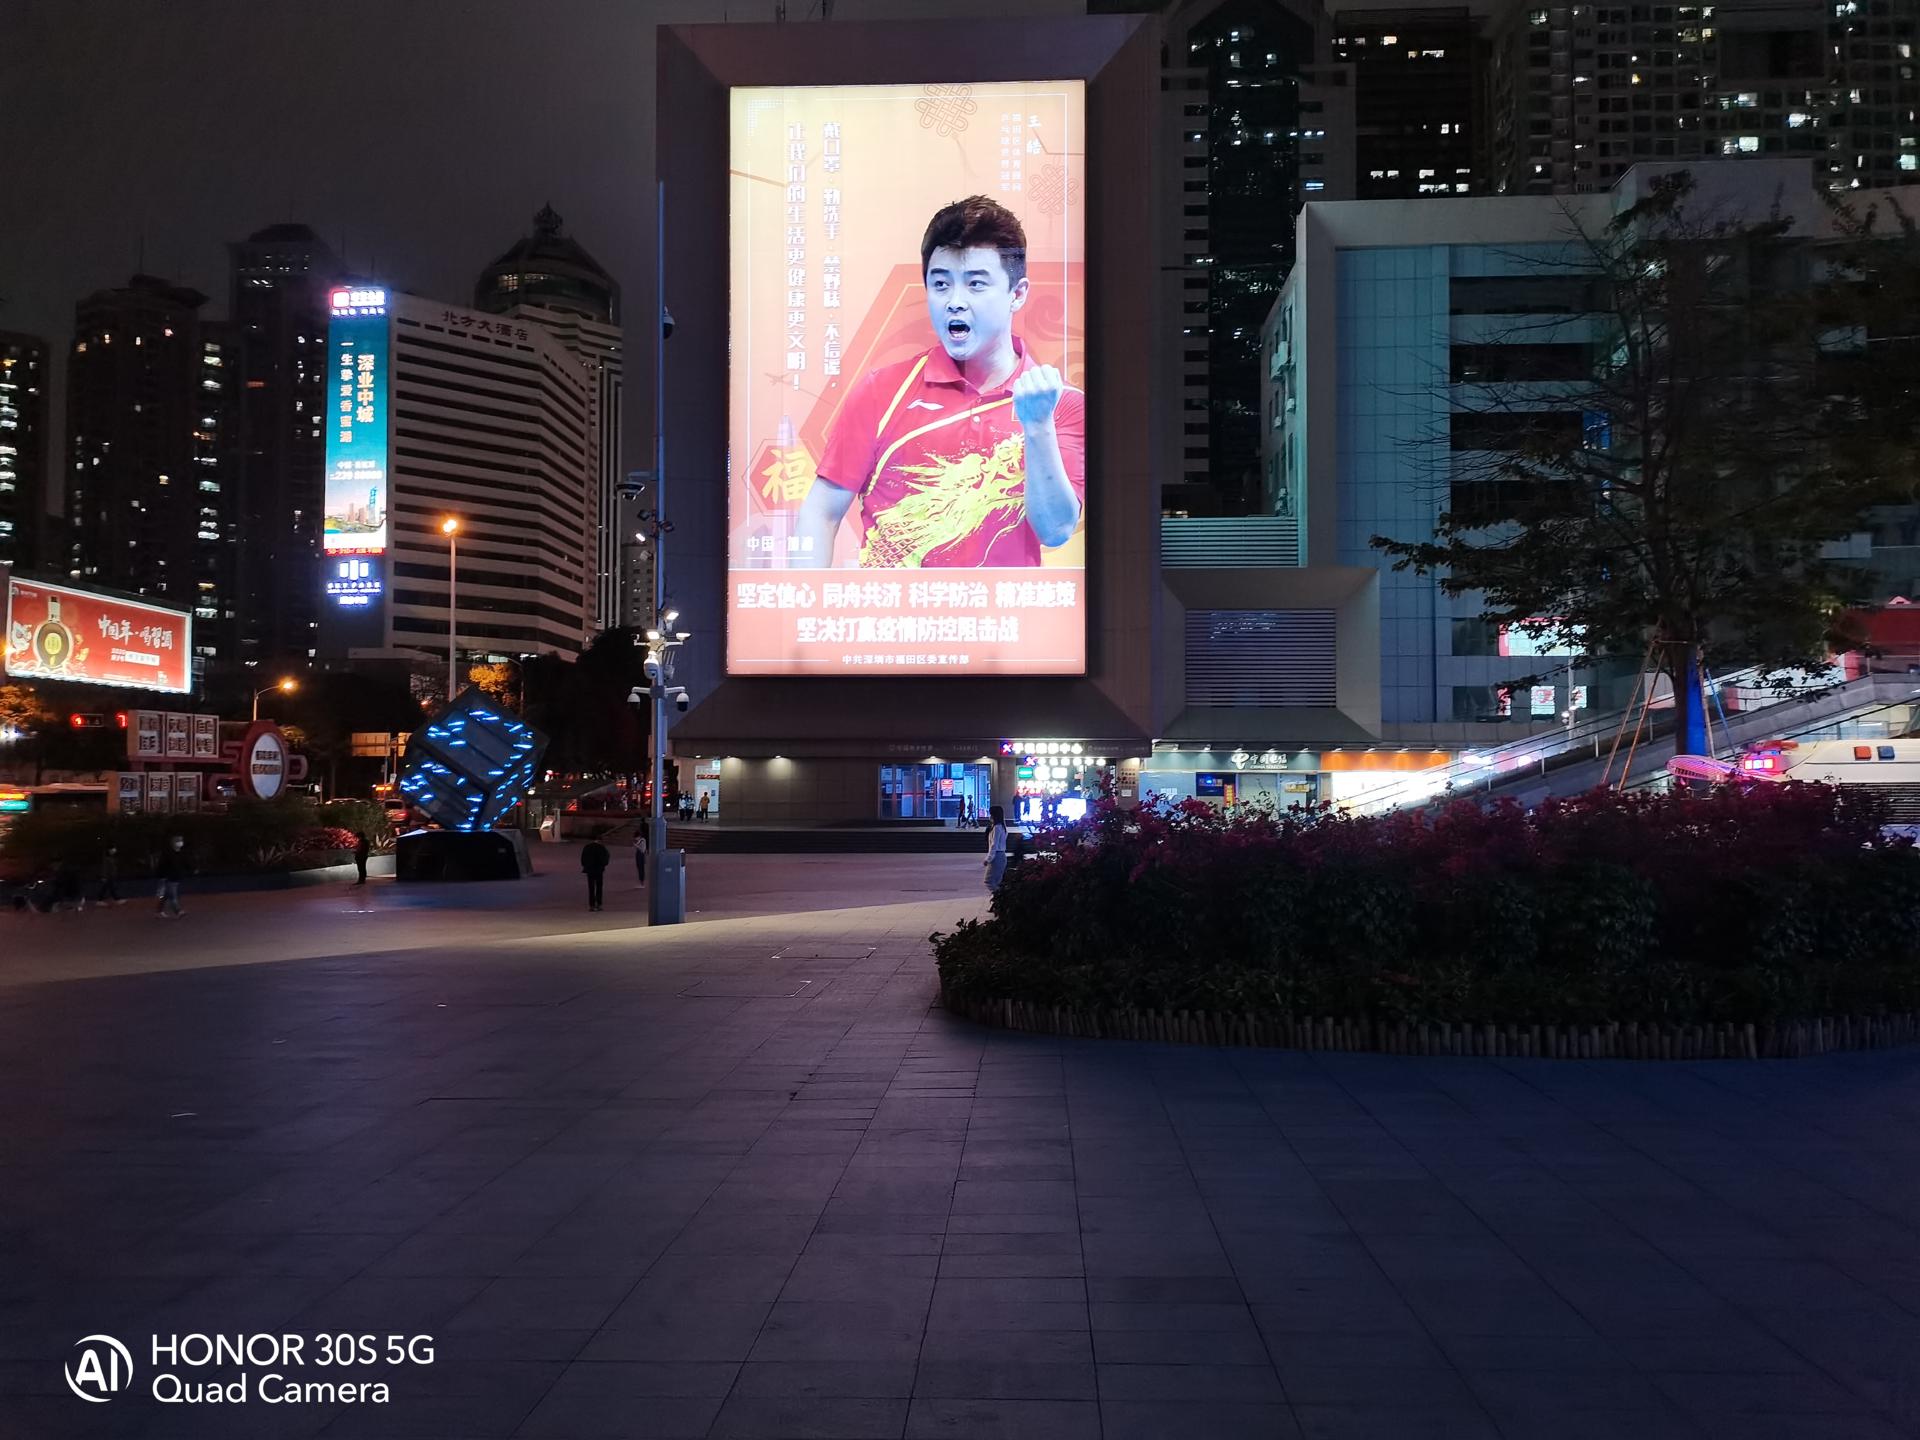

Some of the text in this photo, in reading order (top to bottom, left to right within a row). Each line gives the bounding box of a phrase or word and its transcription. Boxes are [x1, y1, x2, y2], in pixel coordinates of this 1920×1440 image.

[441, 310, 529, 341] 北方大酒店
[356, 354, 375, 423] 深业中城
[761, 446, 809, 504] 福
[737, 582, 1076, 608] 坚定信心 同舟共济 科学防治 精准施策
[796, 616, 1019, 643] 坚决打赢疫情防控阻击战
[842, 654, 969, 666] 中共深圳市福田区委宣传部
[1250, 753, 1287, 765] 中国电信
